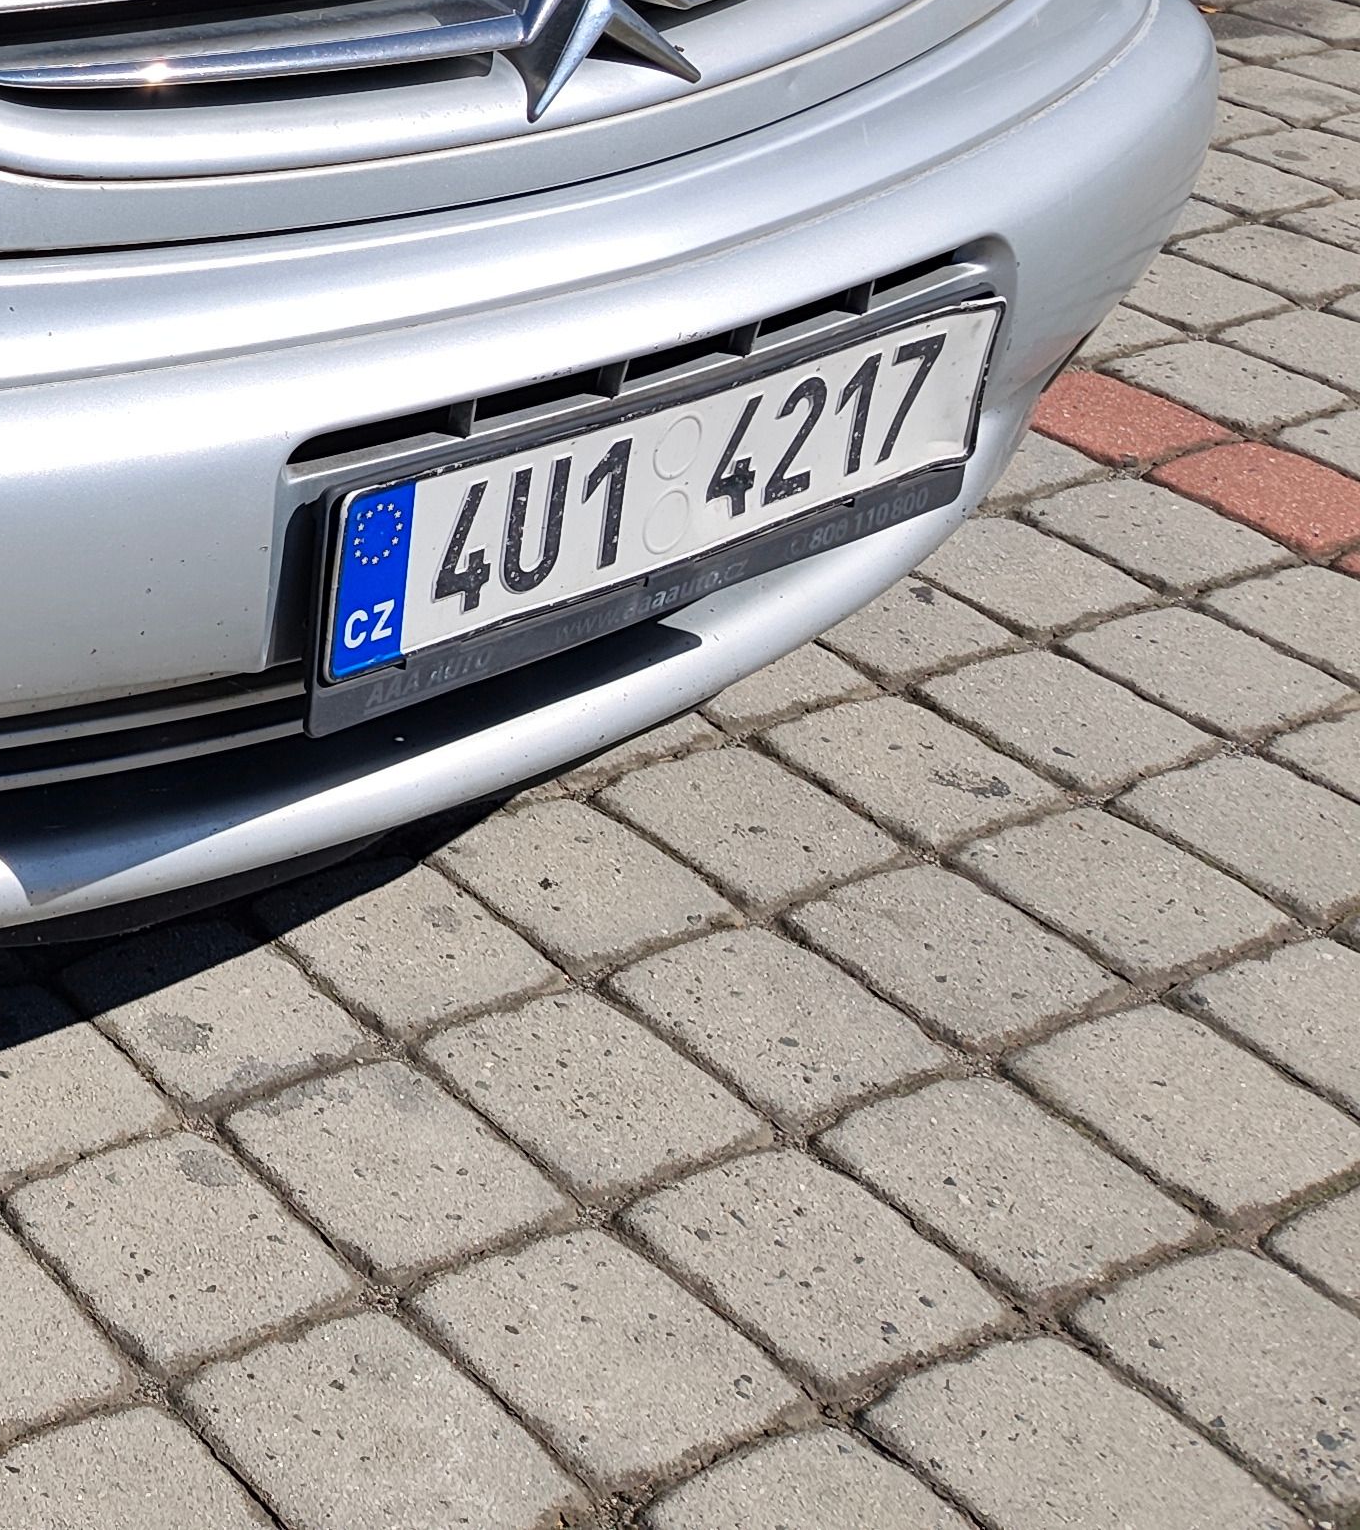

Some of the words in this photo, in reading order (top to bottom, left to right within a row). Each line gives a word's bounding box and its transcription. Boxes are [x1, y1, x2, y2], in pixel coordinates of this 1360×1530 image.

[432, 437, 635, 613] 4U1
[705, 332, 948, 518] 4217
[343, 598, 395, 650] CZ
